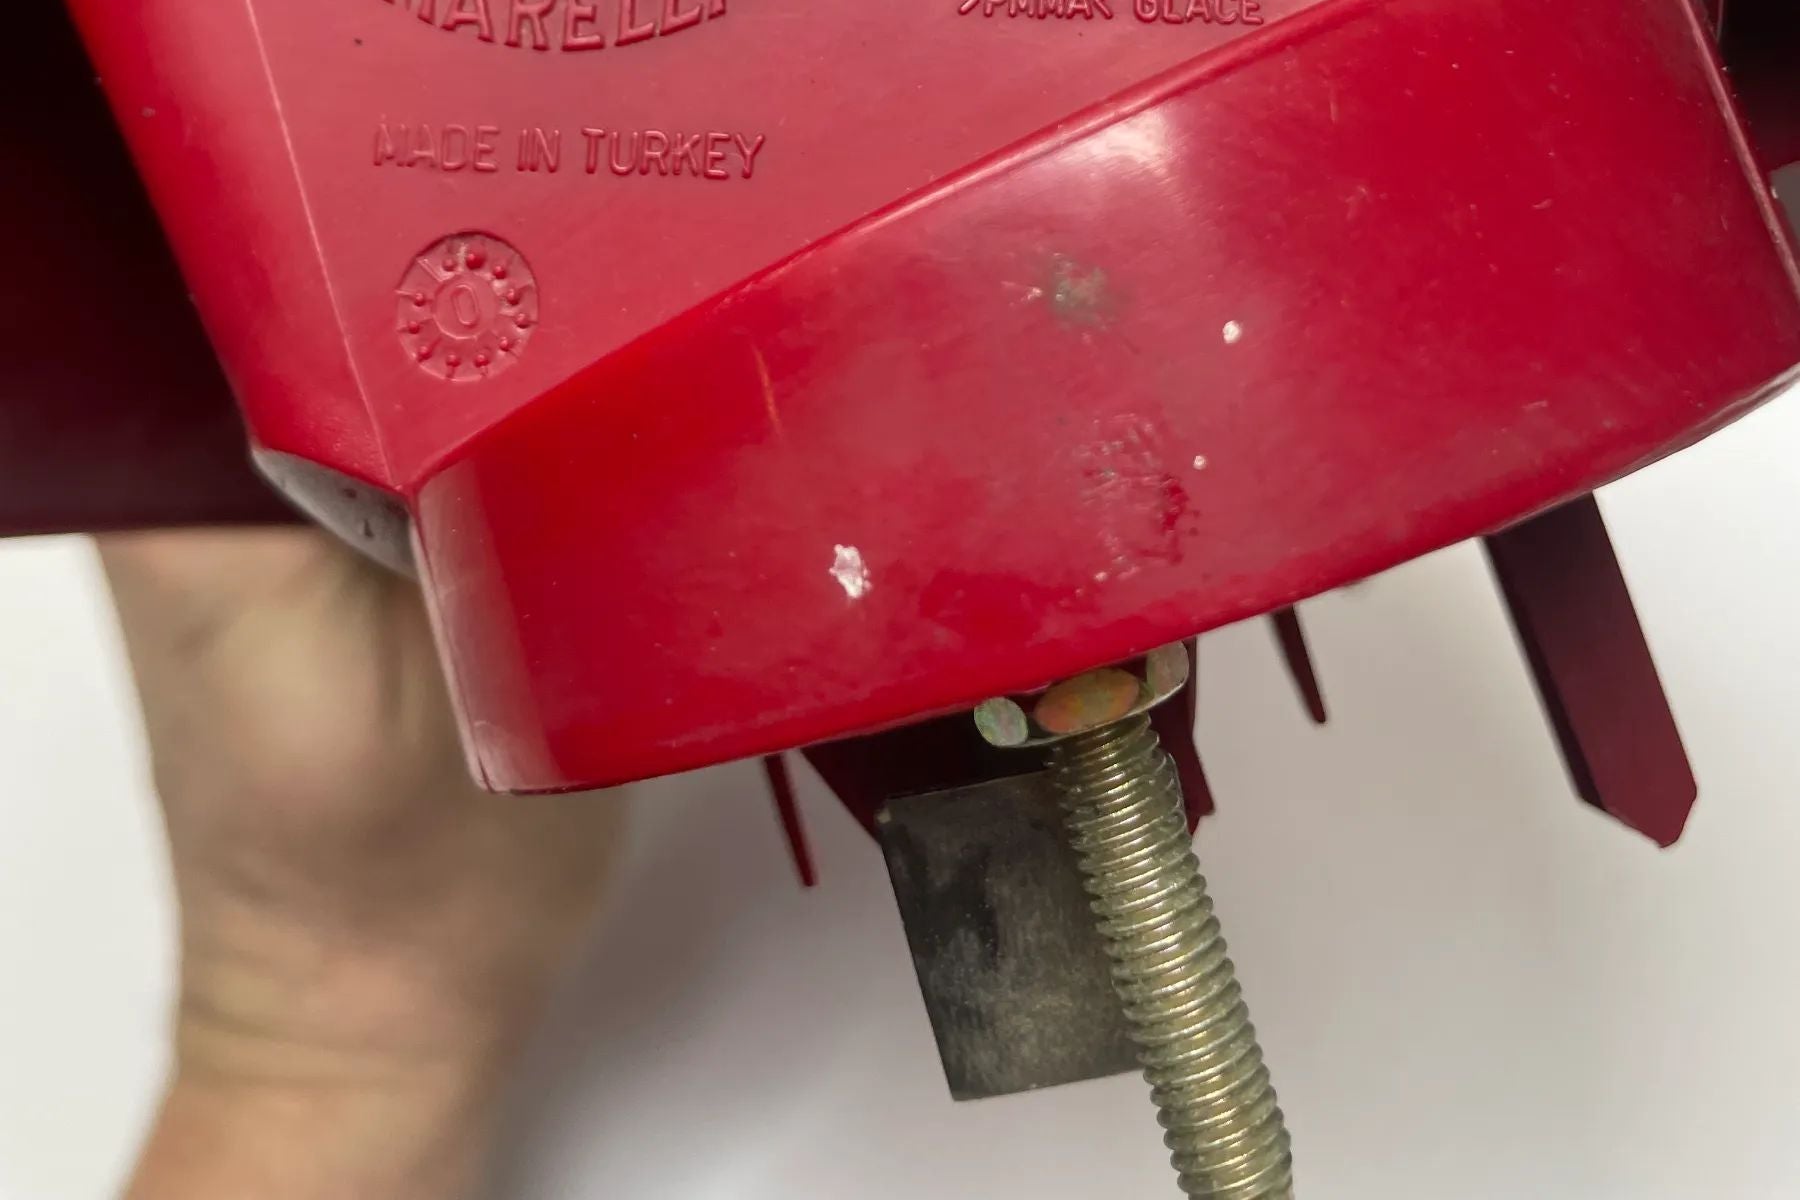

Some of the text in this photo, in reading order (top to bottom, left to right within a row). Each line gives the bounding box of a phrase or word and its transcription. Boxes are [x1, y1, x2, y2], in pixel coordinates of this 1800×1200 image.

[373, 122, 766, 181] MADE IN TURKEY
